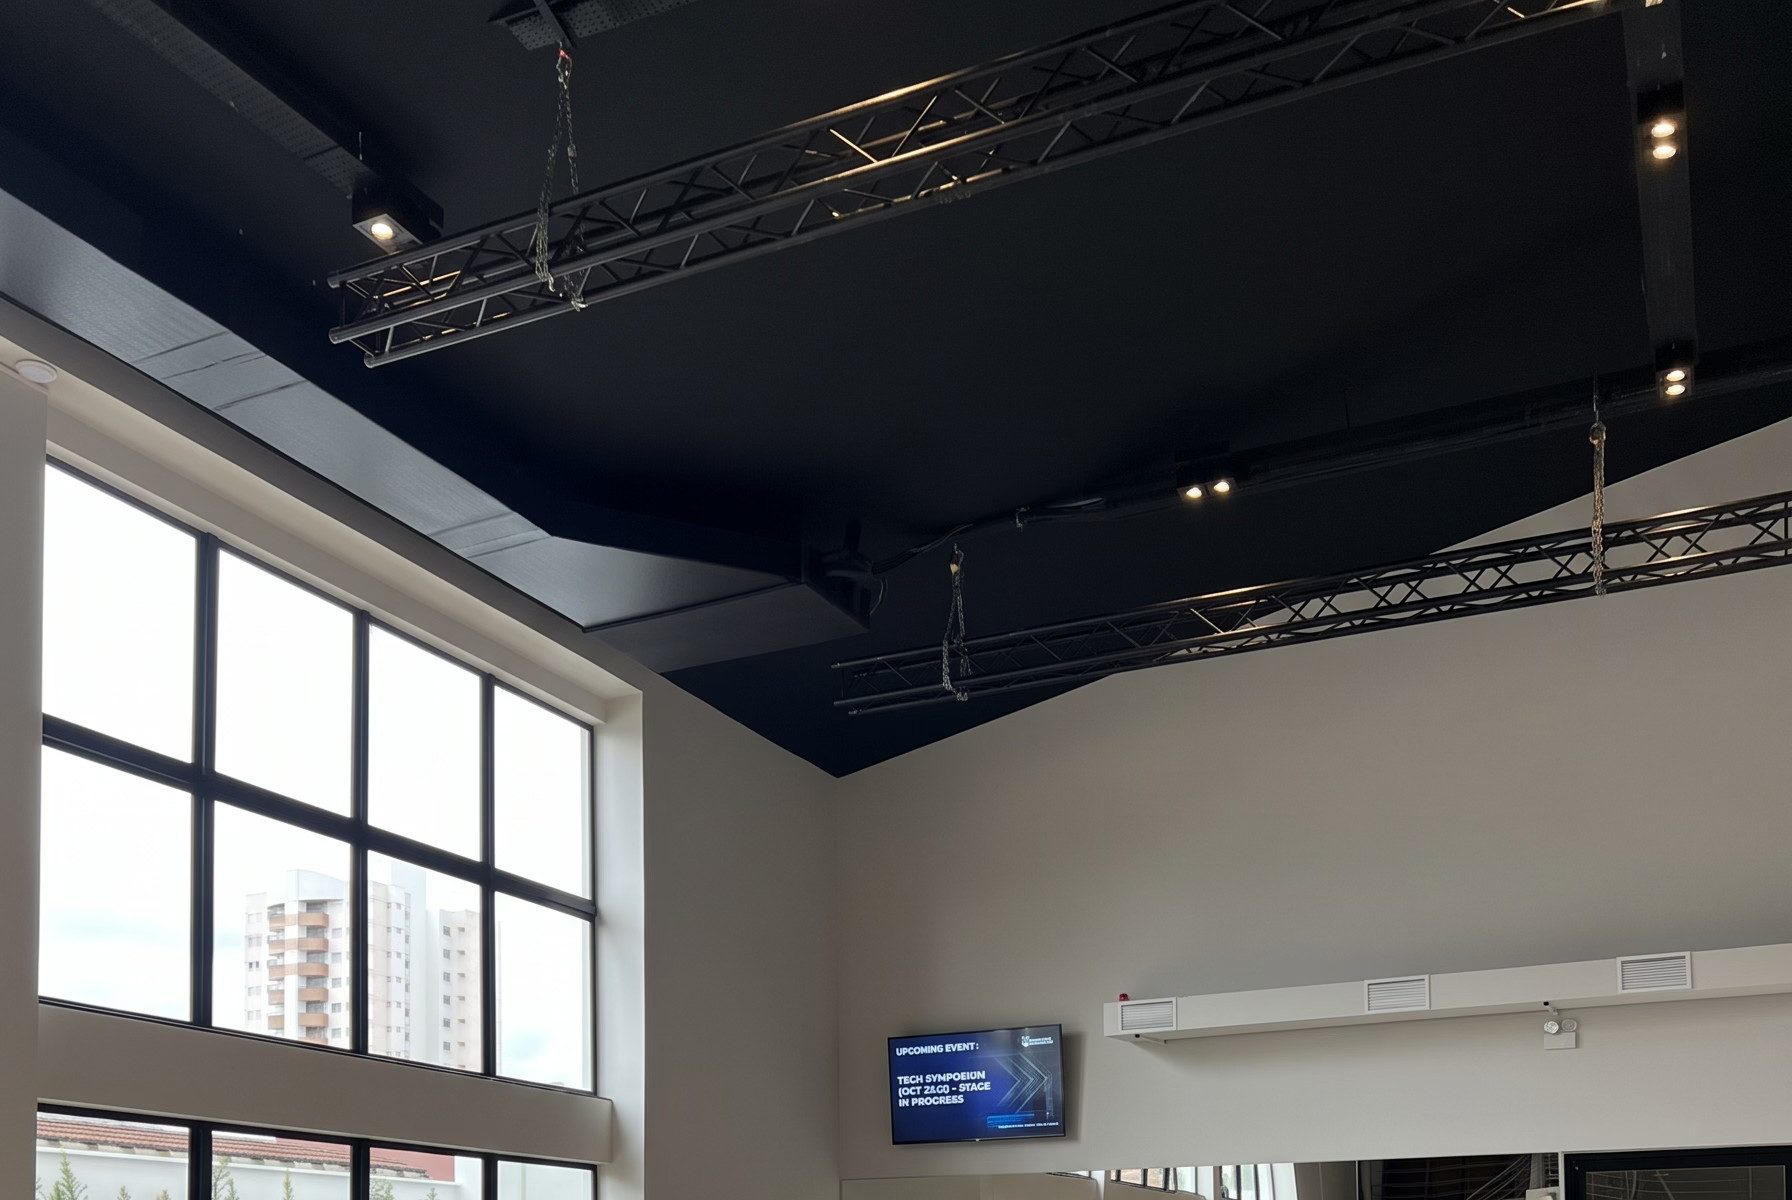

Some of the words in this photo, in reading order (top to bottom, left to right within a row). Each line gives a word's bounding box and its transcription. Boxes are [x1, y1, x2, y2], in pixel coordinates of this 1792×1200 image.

[895, 1044, 943, 1056] UPCOMING
[945, 1042, 979, 1053] EVENT:
[897, 1075, 923, 1085] TECH
[898, 1098, 909, 1107] IN
